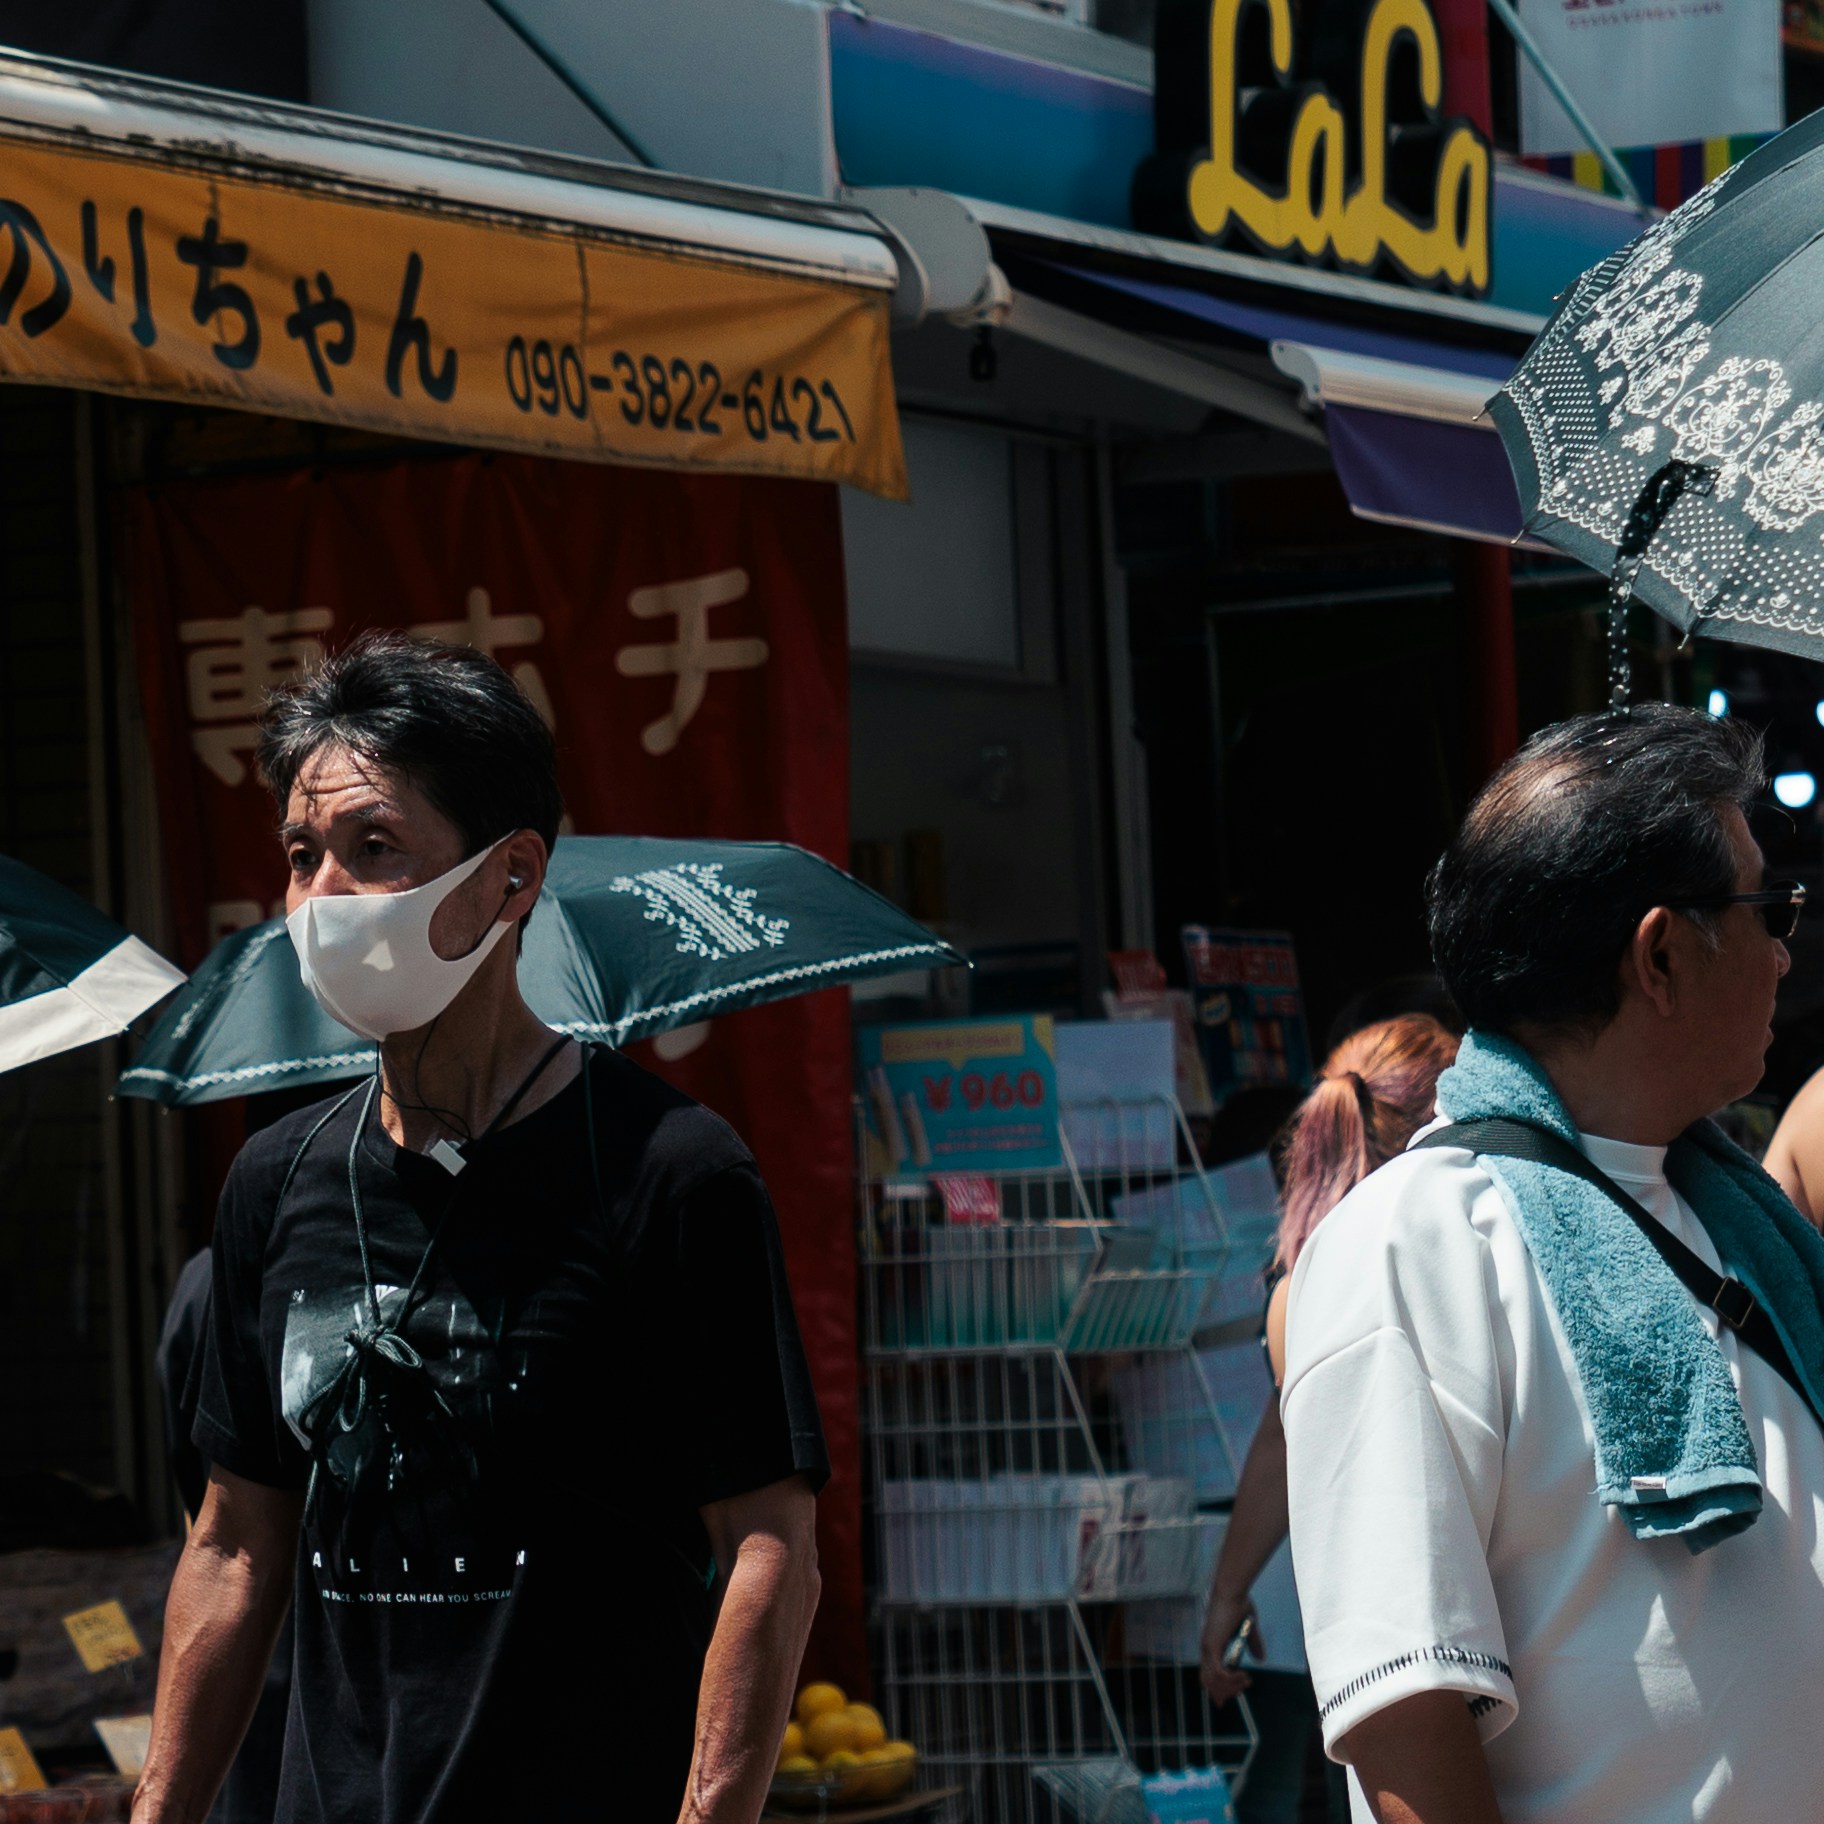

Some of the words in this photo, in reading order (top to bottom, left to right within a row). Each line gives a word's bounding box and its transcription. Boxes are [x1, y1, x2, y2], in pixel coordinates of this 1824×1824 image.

[505, 334, 857, 444] 090-3822-6421
[359, 1592, 375, 1603] NO
[395, 1593, 417, 1603] CAN
[419, 1592, 445, 1603] HEAR
[448, 1592, 469, 1604] YOU
